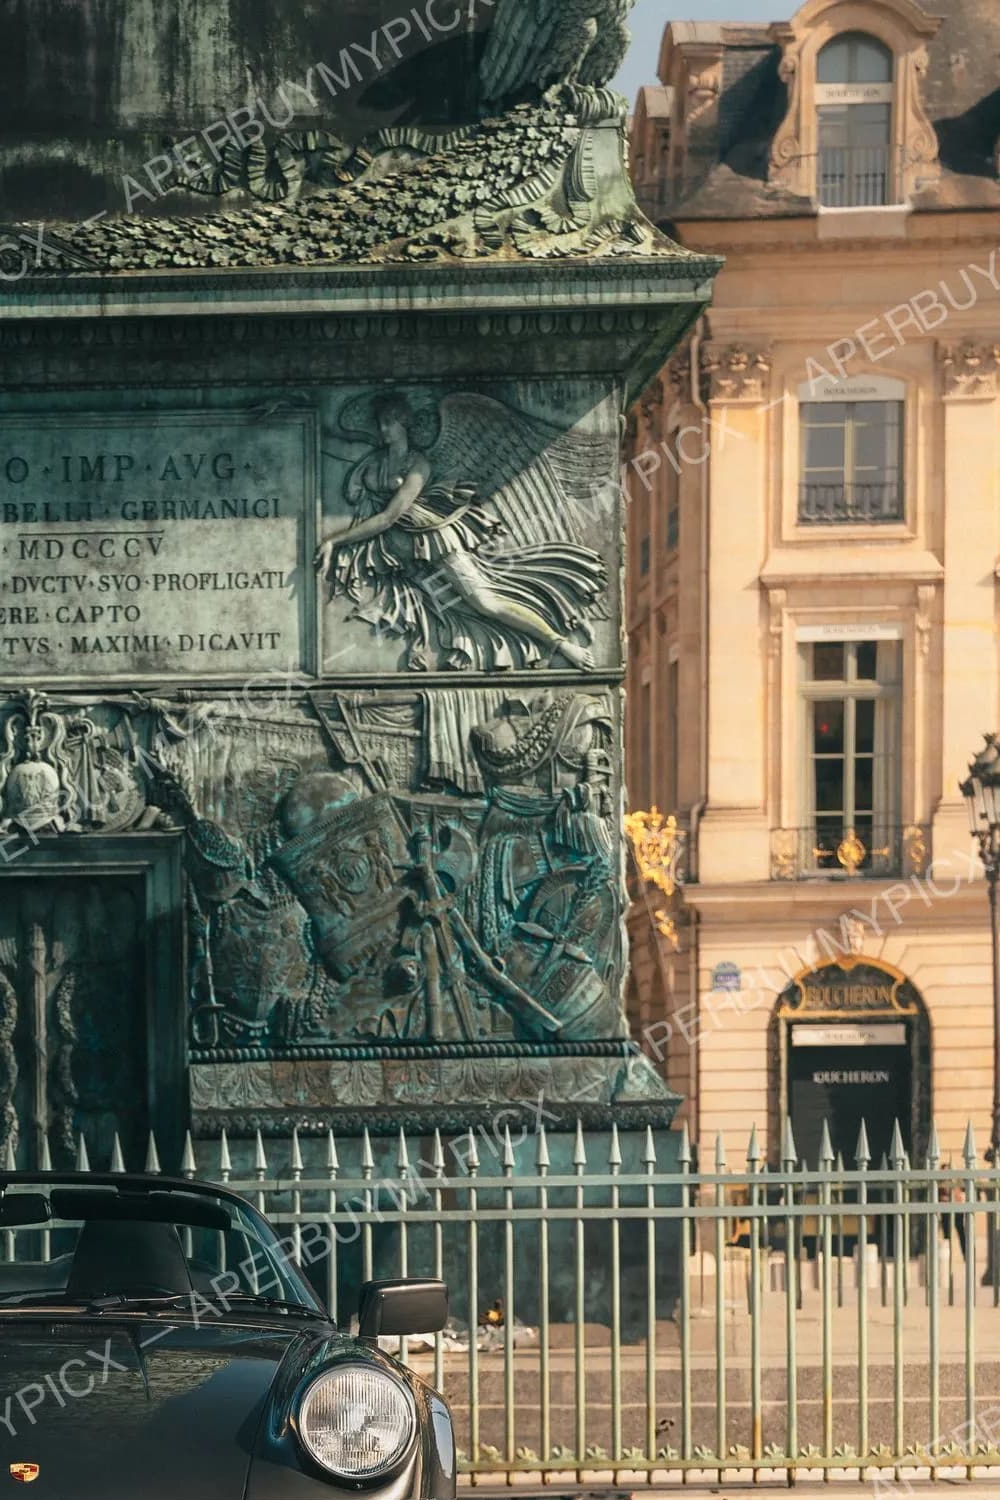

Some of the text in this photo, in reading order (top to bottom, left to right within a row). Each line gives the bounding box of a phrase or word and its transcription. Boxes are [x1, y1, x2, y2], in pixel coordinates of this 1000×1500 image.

[61, 454, 135, 483] IMP
[160, 453, 236, 481] AVG
[2, 502, 92, 523] BELLI
[121, 498, 280, 521] GERMANICI
[18, 536, 163, 560] MDCCCV
[12, 575, 87, 594] DVCTV
[98, 574, 141, 592] SVO
[153, 571, 284, 591] PROFLIGATI
[56, 605, 141, 624] CAPTO
[71, 635, 160, 654] MAXIMI
[179, 632, 281, 651] DICAVIT
